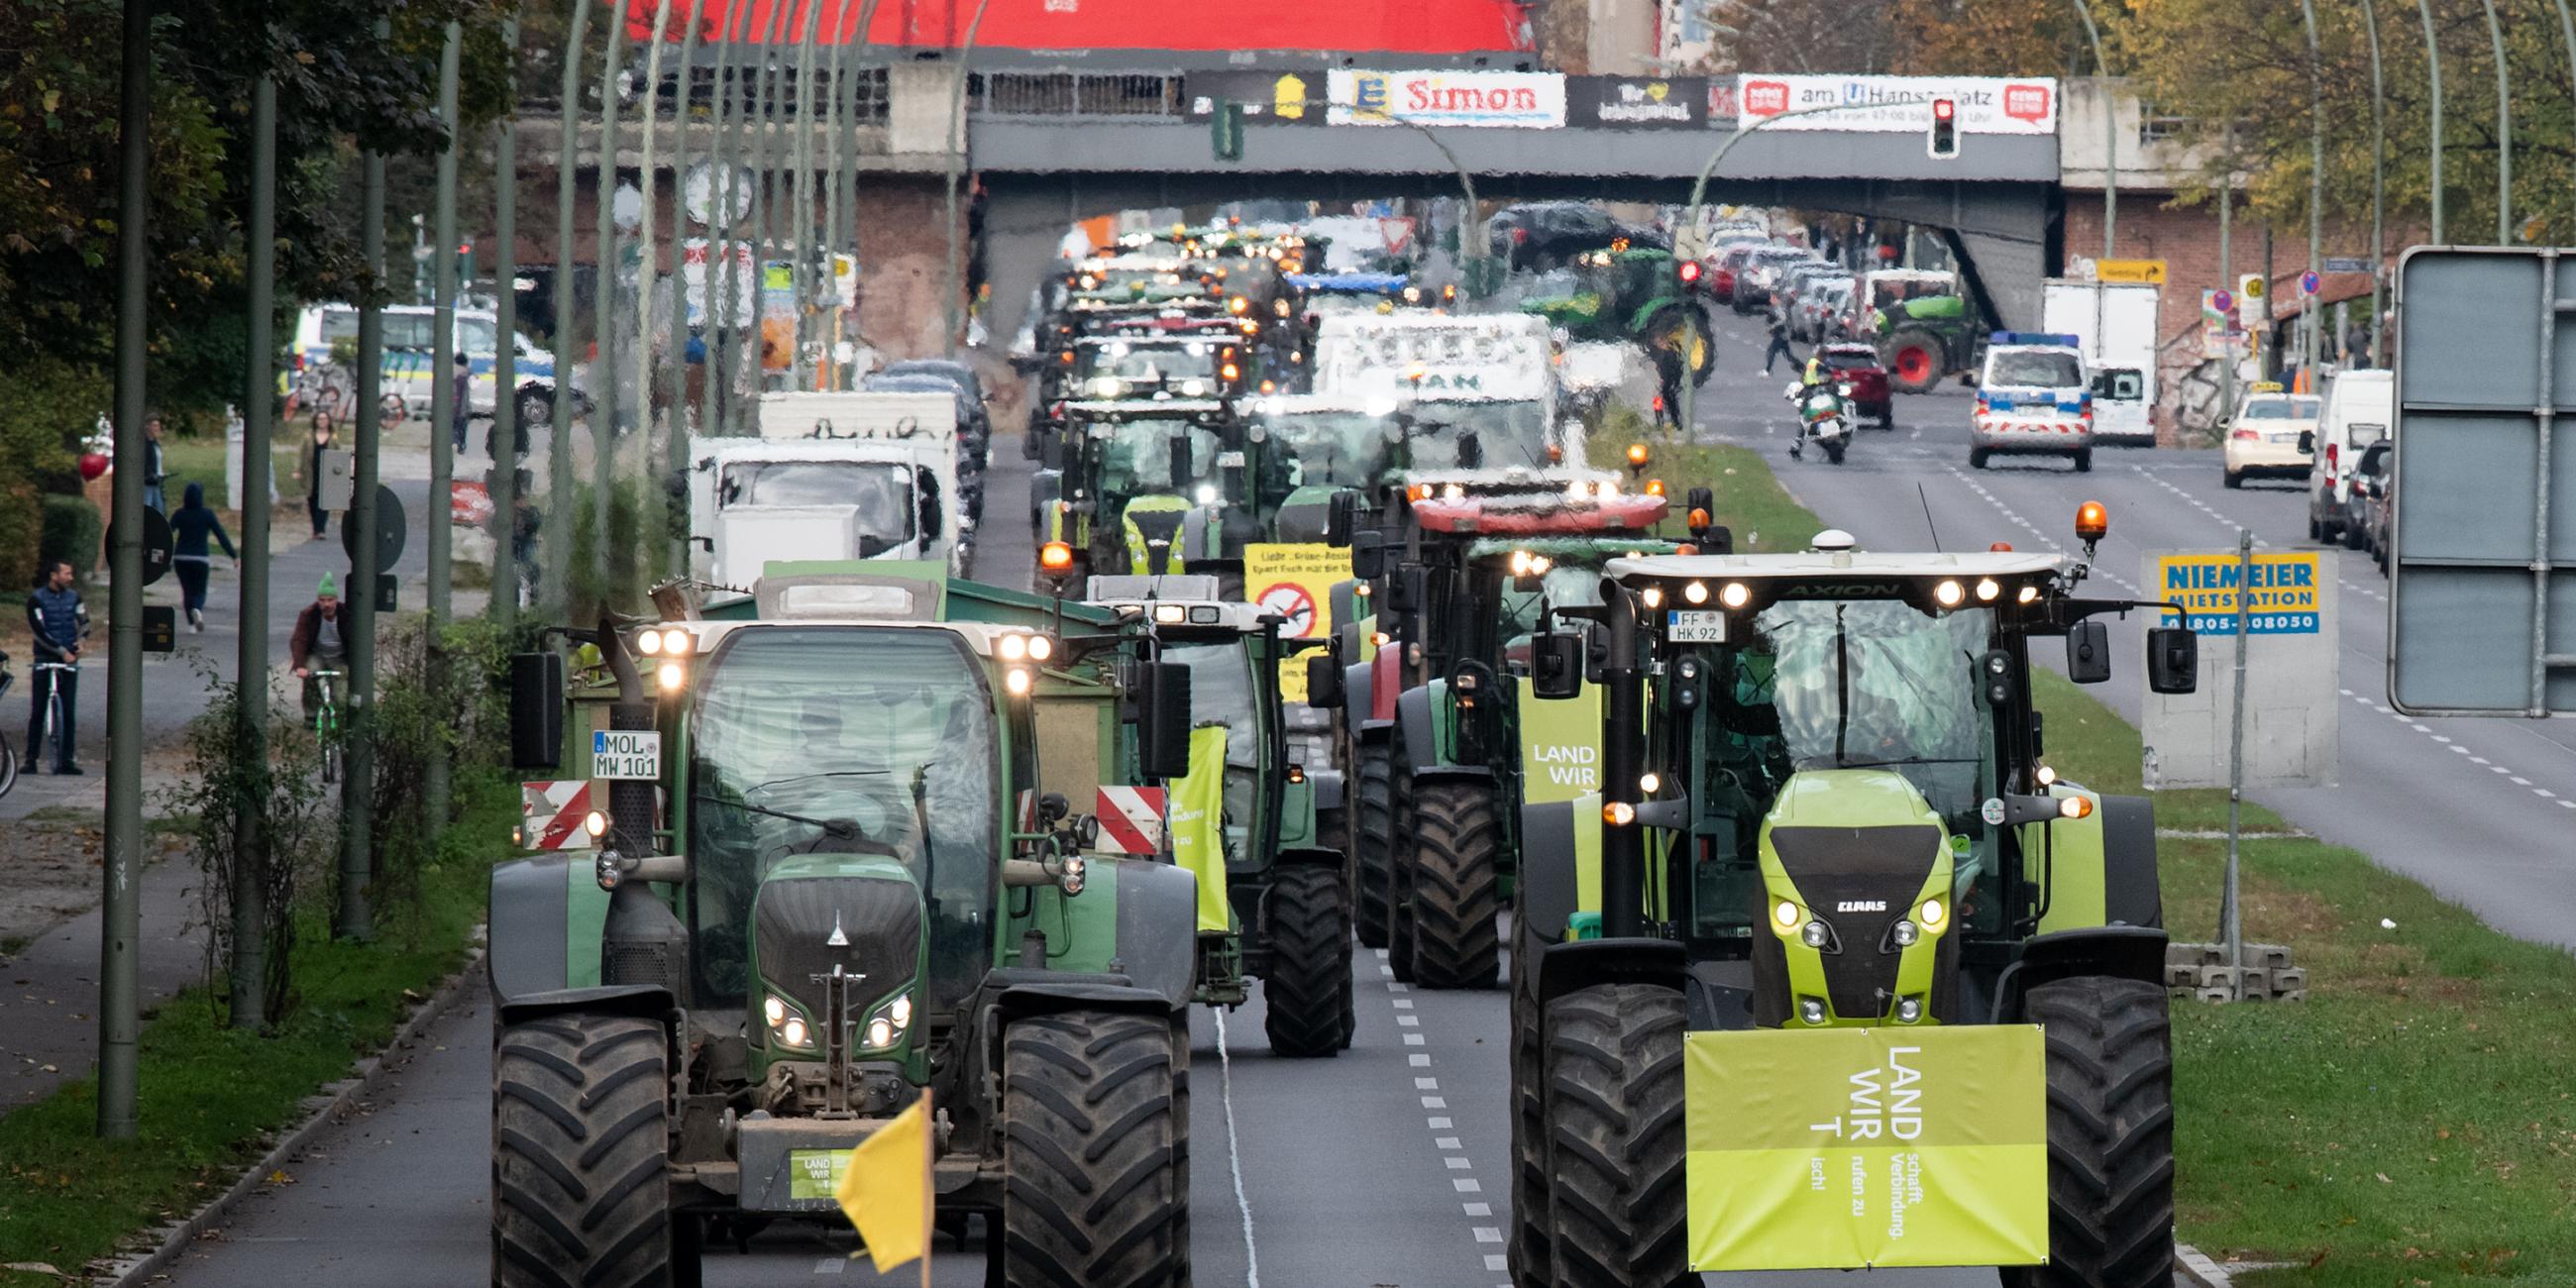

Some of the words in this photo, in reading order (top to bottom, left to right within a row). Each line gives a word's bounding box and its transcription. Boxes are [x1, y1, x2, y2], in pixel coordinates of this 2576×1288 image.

[1406, 79, 1537, 111] Simon
[1801, 88, 1835, 103] am
[1870, 85, 1992, 106] Hansatz
[2167, 563, 2313, 590] NIEMEIER
[1784, 584, 1900, 595] AXION
[1681, 612, 1699, 626] FF
[2168, 615, 2312, 631] 0805-08050
[1676, 627, 1697, 640] HK
[1699, 627, 1717, 640] 92
[605, 735, 644, 754] MOL
[1533, 745, 1595, 764] LAND
[596, 757, 619, 776] MW
[623, 757, 656, 777] 101
[1549, 766, 1596, 786] WIR
[1838, 901, 1887, 912] CLAAS
[1889, 1046, 1922, 1139] LAND
[1849, 1068, 1882, 1140] WIR
[1810, 1116, 1842, 1137] T
[805, 1158, 830, 1169] LAND
[1811, 1156, 1826, 1190] isch!
[810, 1170, 830, 1179] WIR
[823, 1180, 830, 1189] T
[1852, 1156, 1868, 1195] rufen
[1906, 1153, 1923, 1204] schafft
[1888, 1152, 1905, 1240] Verbindung.
[1853, 1199, 1864, 1217] zu
